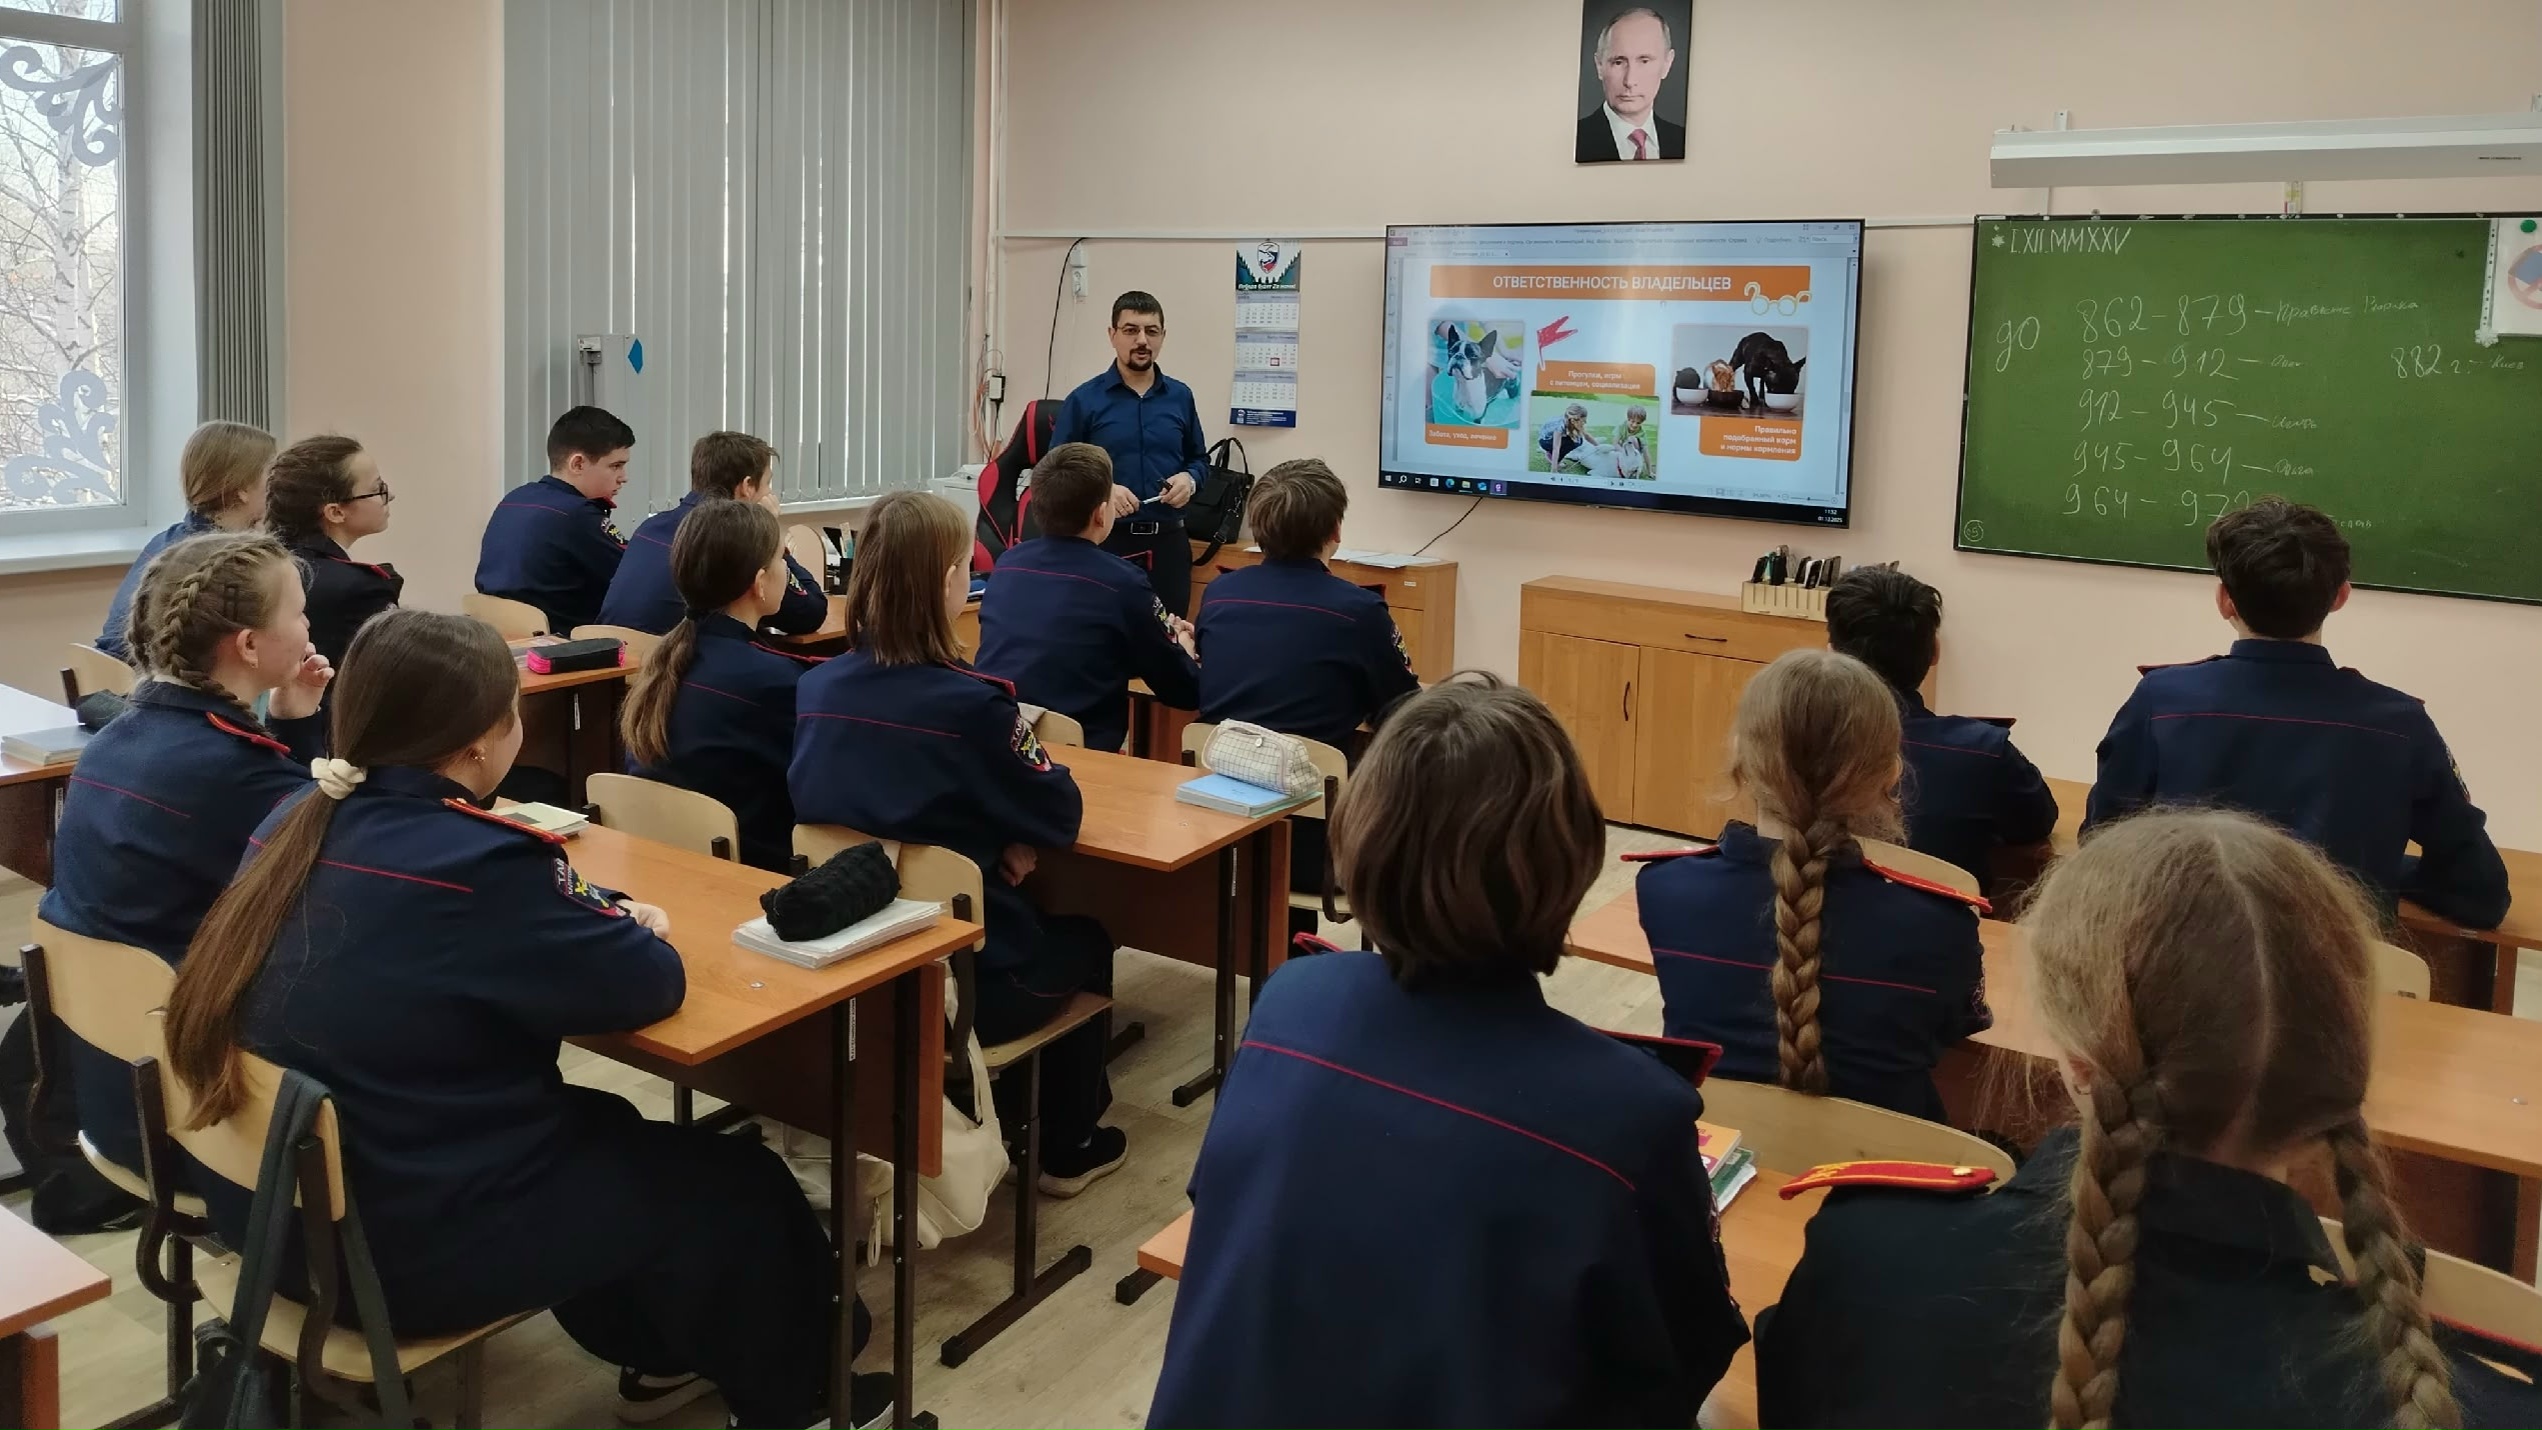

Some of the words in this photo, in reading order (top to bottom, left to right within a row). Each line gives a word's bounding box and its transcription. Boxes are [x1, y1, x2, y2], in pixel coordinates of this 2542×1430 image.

[1493, 275, 1628, 290] ОТВЕТСТВЕННОСТЬ
[1631, 276, 1732, 292] ВЛАДЕЛЬЦЕВ
[2077, 295, 2148, 343] 862
[2178, 293, 2246, 336] 879
[2082, 345, 2132, 380] 879
[2171, 344, 2239, 380] 912
[2390, 343, 2443, 379] 882
[2079, 388, 2123, 432] 912
[2161, 389, 2236, 428] 945
[1723, 434, 1775, 444] подобранный
[1776, 438, 1797, 446] корм
[1754, 425, 1797, 435] Правильно
[1726, 444, 1753, 452] нормы
[1753, 446, 1796, 454] кормления
[2072, 439, 2133, 478] 945
[2161, 438, 2232, 485] 964
[2062, 483, 2128, 519] 964
